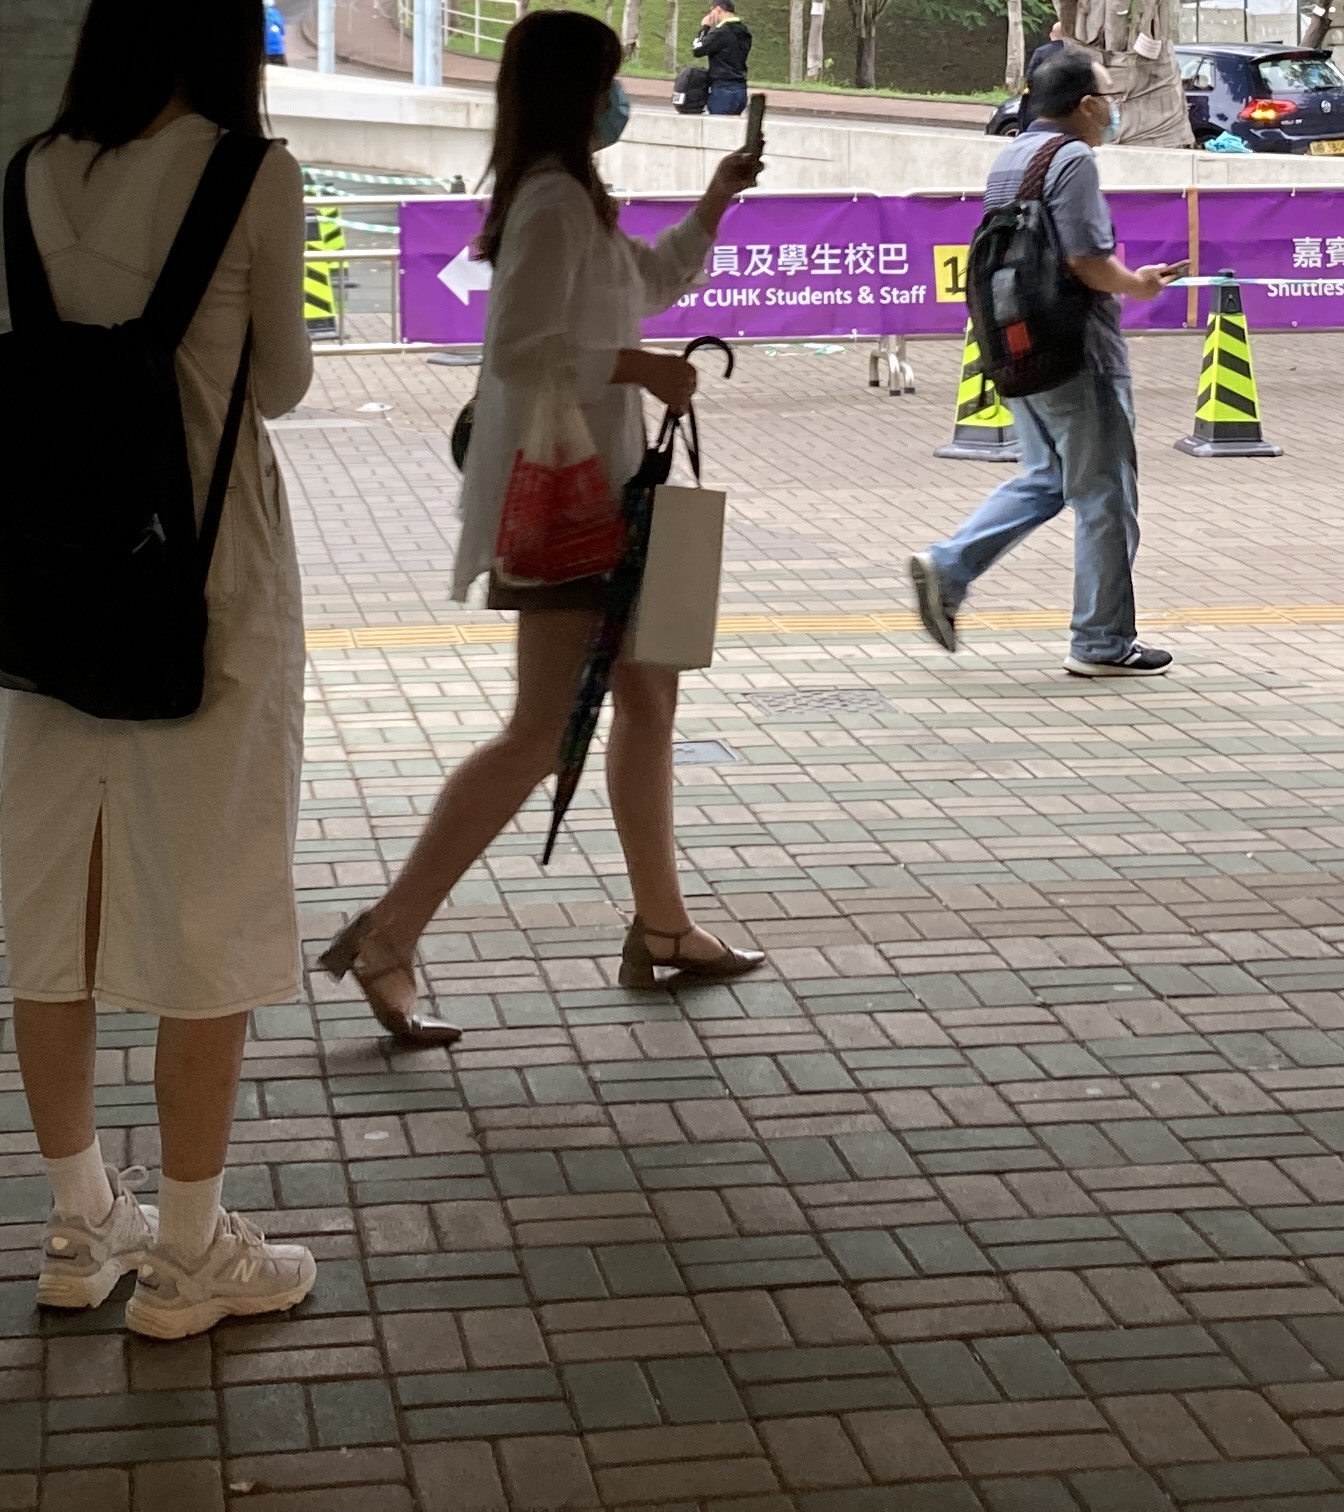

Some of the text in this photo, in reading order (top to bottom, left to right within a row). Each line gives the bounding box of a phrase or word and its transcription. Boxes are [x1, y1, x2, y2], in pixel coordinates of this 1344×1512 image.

[705, 242, 909, 277] 員及學生校巴
[703, 287, 761, 307] CUHK
[765, 284, 854, 305] Students
[857, 285, 875, 304] &
[879, 284, 927, 304] Staff
[1267, 279, 1344, 297] Shuttles
